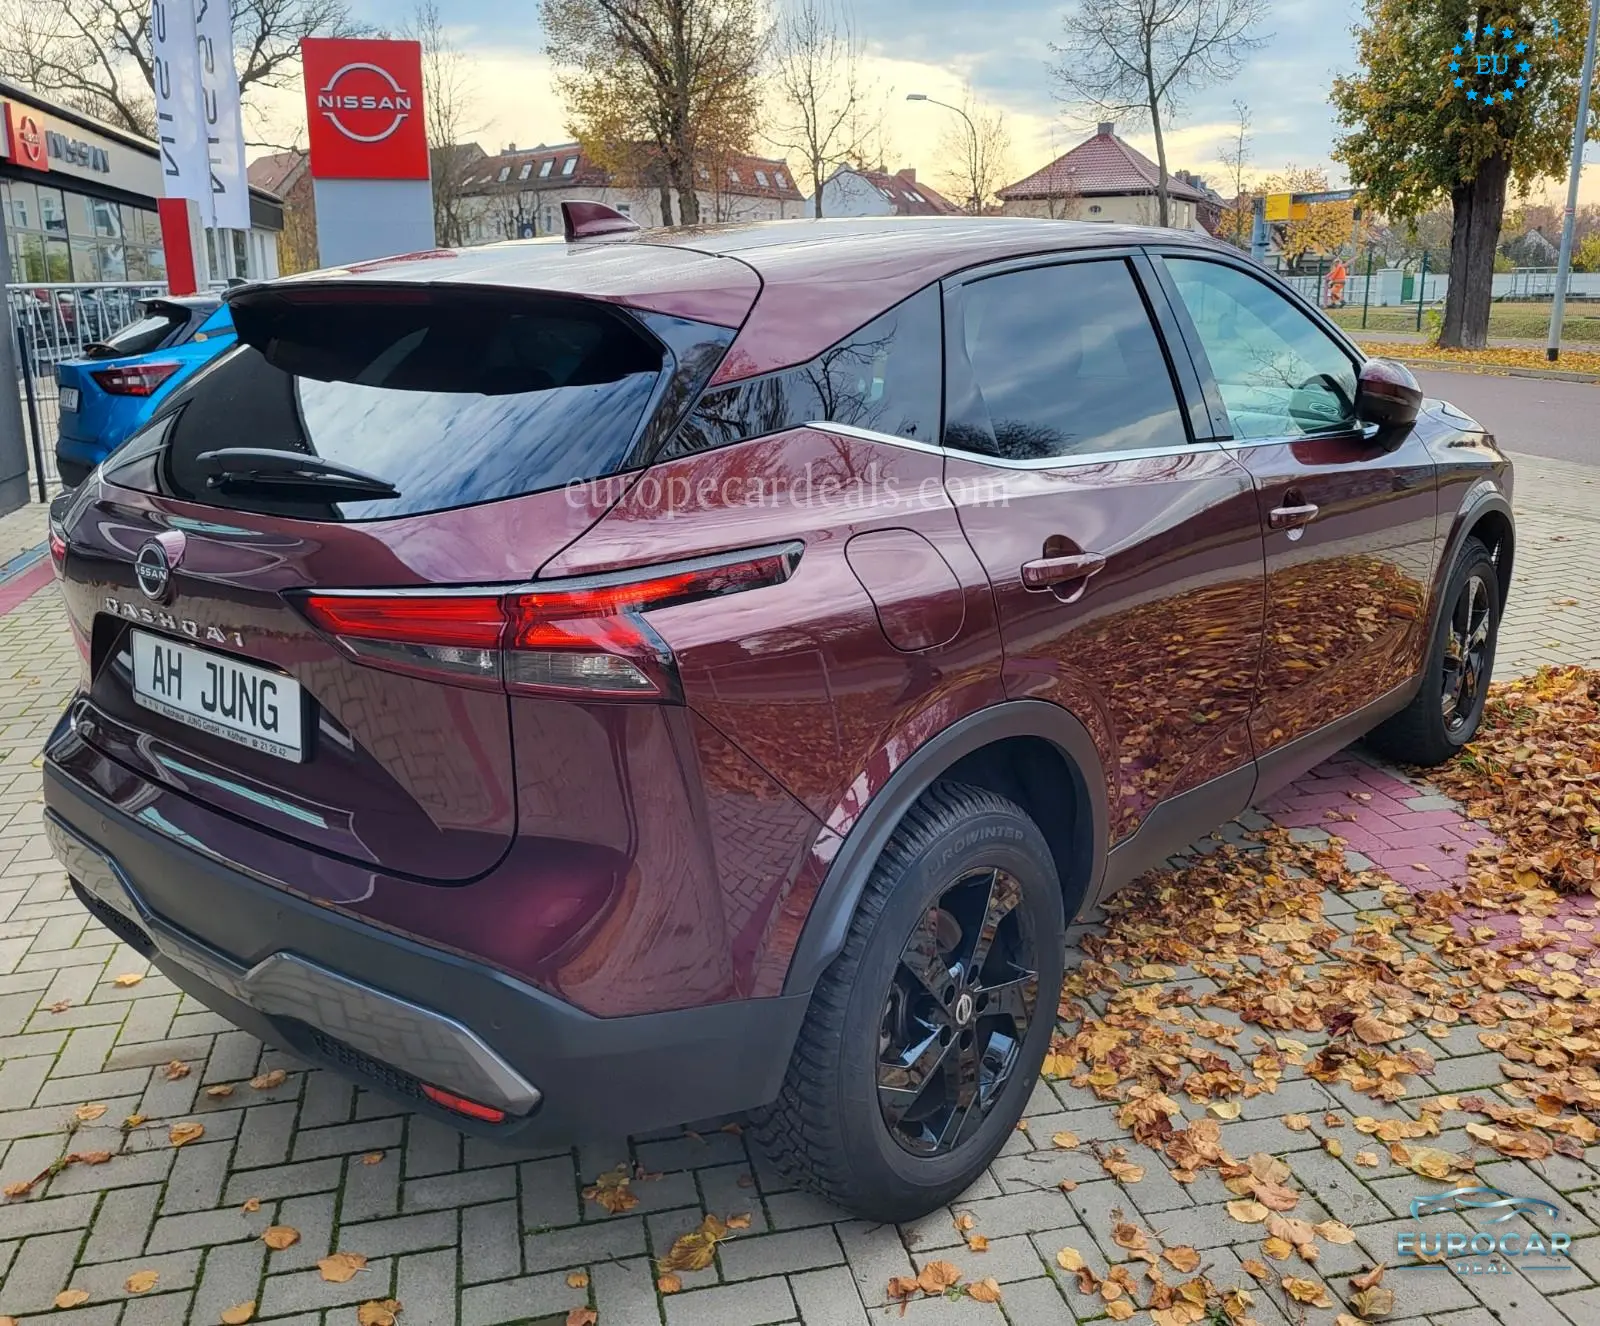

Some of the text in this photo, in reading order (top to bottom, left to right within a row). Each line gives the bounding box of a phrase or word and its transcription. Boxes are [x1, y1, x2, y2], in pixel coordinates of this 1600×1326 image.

[317, 95, 411, 110] NISSAN
[105, 597, 245, 647] QASHQAI
[152, 645, 278, 733] AH JUNG
[928, 825, 1024, 876] UROWINTER
